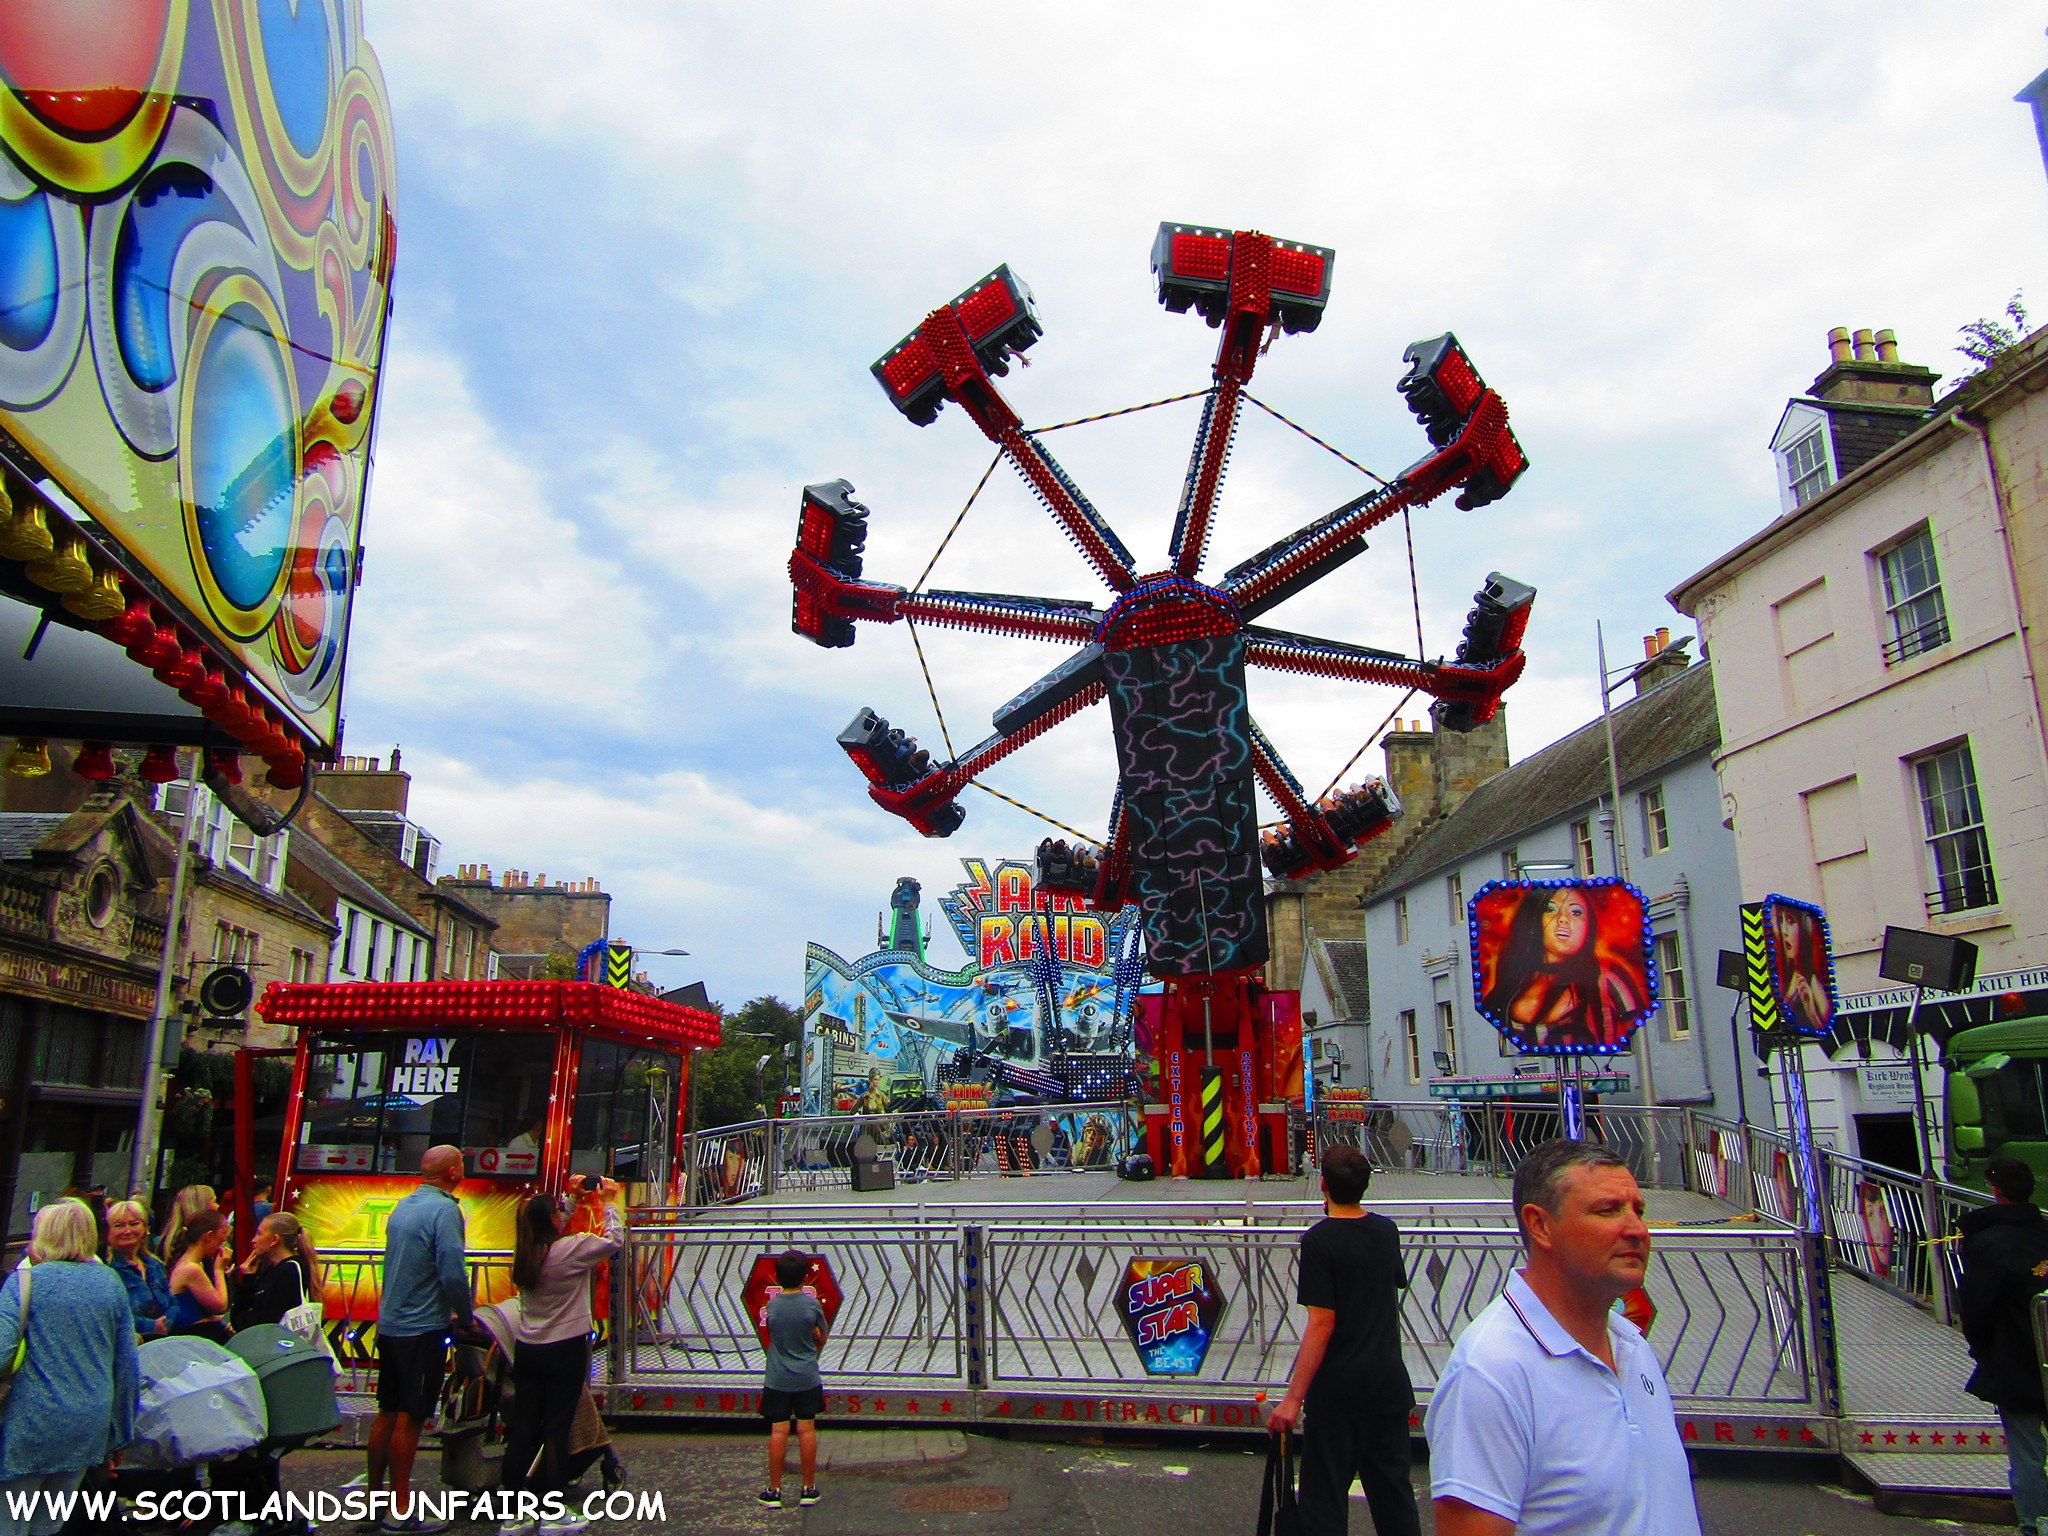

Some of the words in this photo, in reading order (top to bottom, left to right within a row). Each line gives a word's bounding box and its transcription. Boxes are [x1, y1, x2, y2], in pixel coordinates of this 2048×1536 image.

[981, 916, 1105, 969] RAID
[207, 974, 242, 1010] C
[1845, 996, 1873, 1010] KILT
[1978, 976, 2013, 992] KILT
[816, 1025, 855, 1046] CABINS
[391, 1067, 461, 1093] HERE
[952, 1083, 983, 1100] AIR
[1331, 1087, 1359, 1101] AIR
[1171, 1052, 1183, 1146] EXTREME
[1129, 1263, 1203, 1313] SUPER
[1138, 1301, 1200, 1346] STAR
[1148, 1348, 1165, 1357] THE
[1154, 1357, 1195, 1369] BEAST
